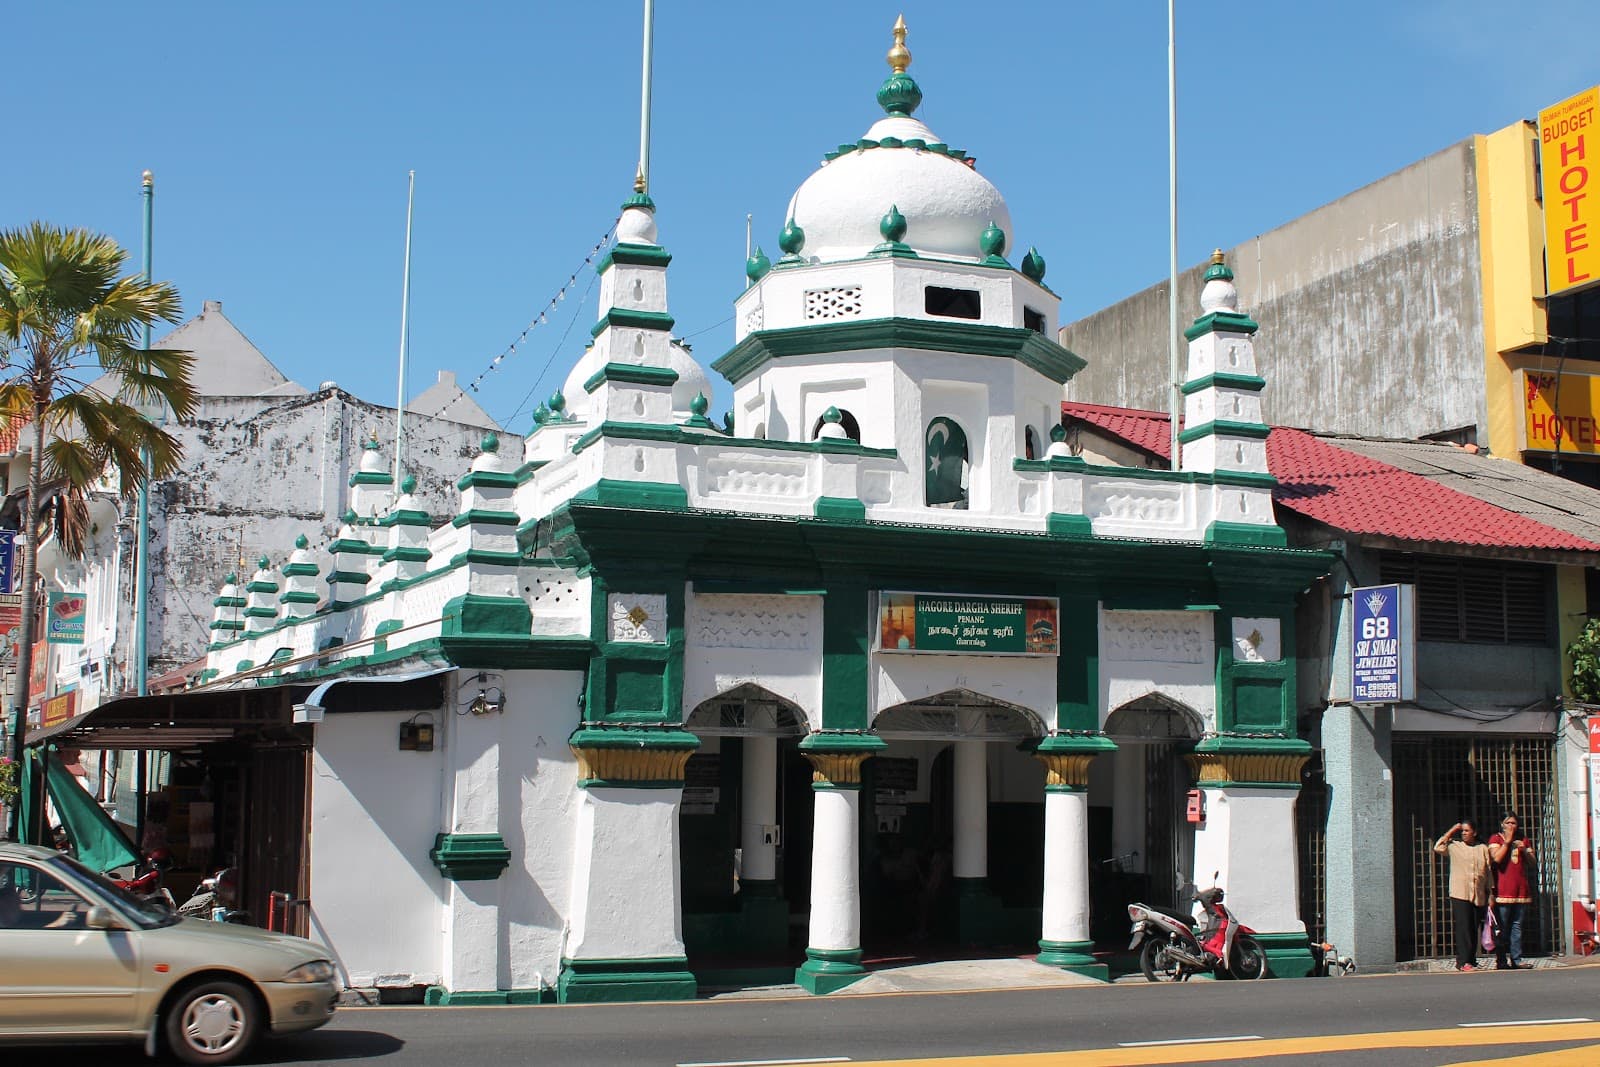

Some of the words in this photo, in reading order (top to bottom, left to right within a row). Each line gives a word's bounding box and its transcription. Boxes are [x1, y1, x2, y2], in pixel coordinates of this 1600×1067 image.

[1543, 107, 1594, 144] BUDGET
[1559, 134, 1590, 284] HOTEL
[1532, 413, 1600, 445] HOTEL
[918, 601, 953, 614] NAGORE
[954, 602, 989, 614] DARGHA
[990, 604, 1023, 615] SHERIFF
[957, 615, 985, 624] PENANG
[1362, 617, 1389, 639] 68
[1356, 642, 1370, 656] SRI
[1371, 639, 1396, 655] SINAR
[1356, 656, 1396, 668] JEWELLERS
